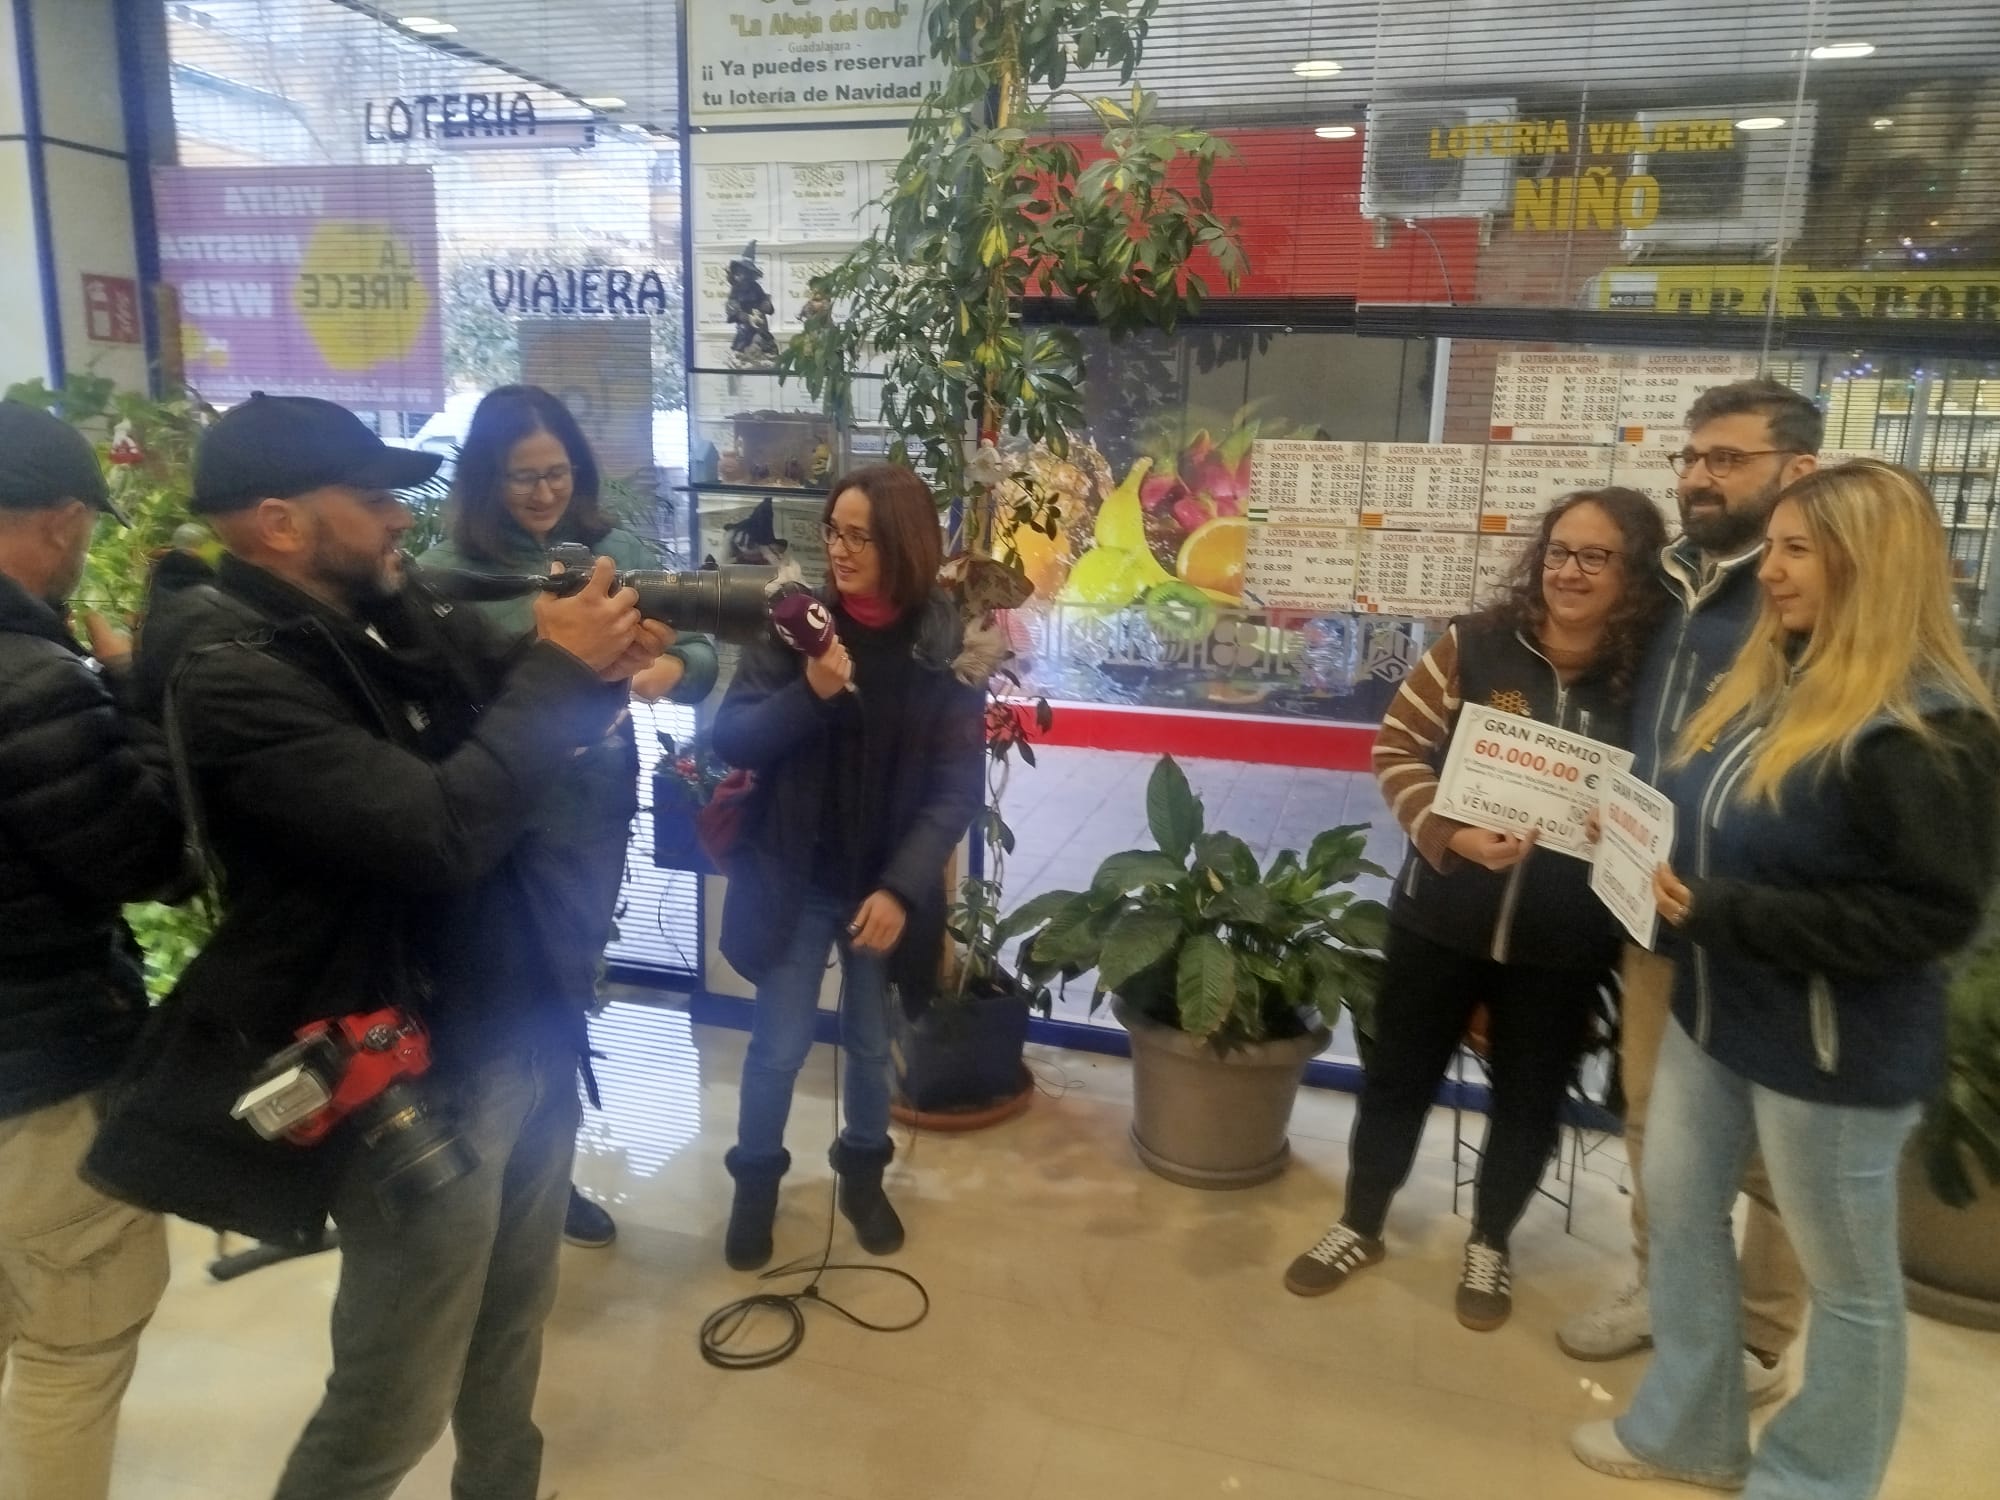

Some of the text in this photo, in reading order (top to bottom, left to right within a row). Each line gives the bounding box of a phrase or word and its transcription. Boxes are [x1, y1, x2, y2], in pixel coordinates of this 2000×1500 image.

[769, 13, 823, 39] Abeja
[829, 9, 858, 33] del
[865, 7, 909, 31] Oro"
[787, 41, 851, 54] Guadalajara
[720, 60, 745, 76] Ya
[752, 57, 827, 79] puedes
[834, 53, 927, 72] reservar
[702, 90, 722, 106] tu
[803, 86, 829, 102] de
[836, 81, 922, 101] Navidad
[365, 92, 537, 145] LOTERIA
[1429, 117, 1736, 160] LOTERIA VIAJERA
[1513, 166, 1662, 231] NIÑO
[488, 268, 668, 315] VIAJERA
[1556, 366, 1572, 374] DEL
[1304, 453, 1319, 461] DEL
[1545, 460, 1561, 468] DEL
[1416, 545, 1430, 553] DEL
[1484, 719, 1601, 765] GRAN PREMIO
[1474, 739, 1580, 784] 60.000,00
[1584, 774, 1600, 791] €
[1462, 794, 1530, 825] VENDIDO
